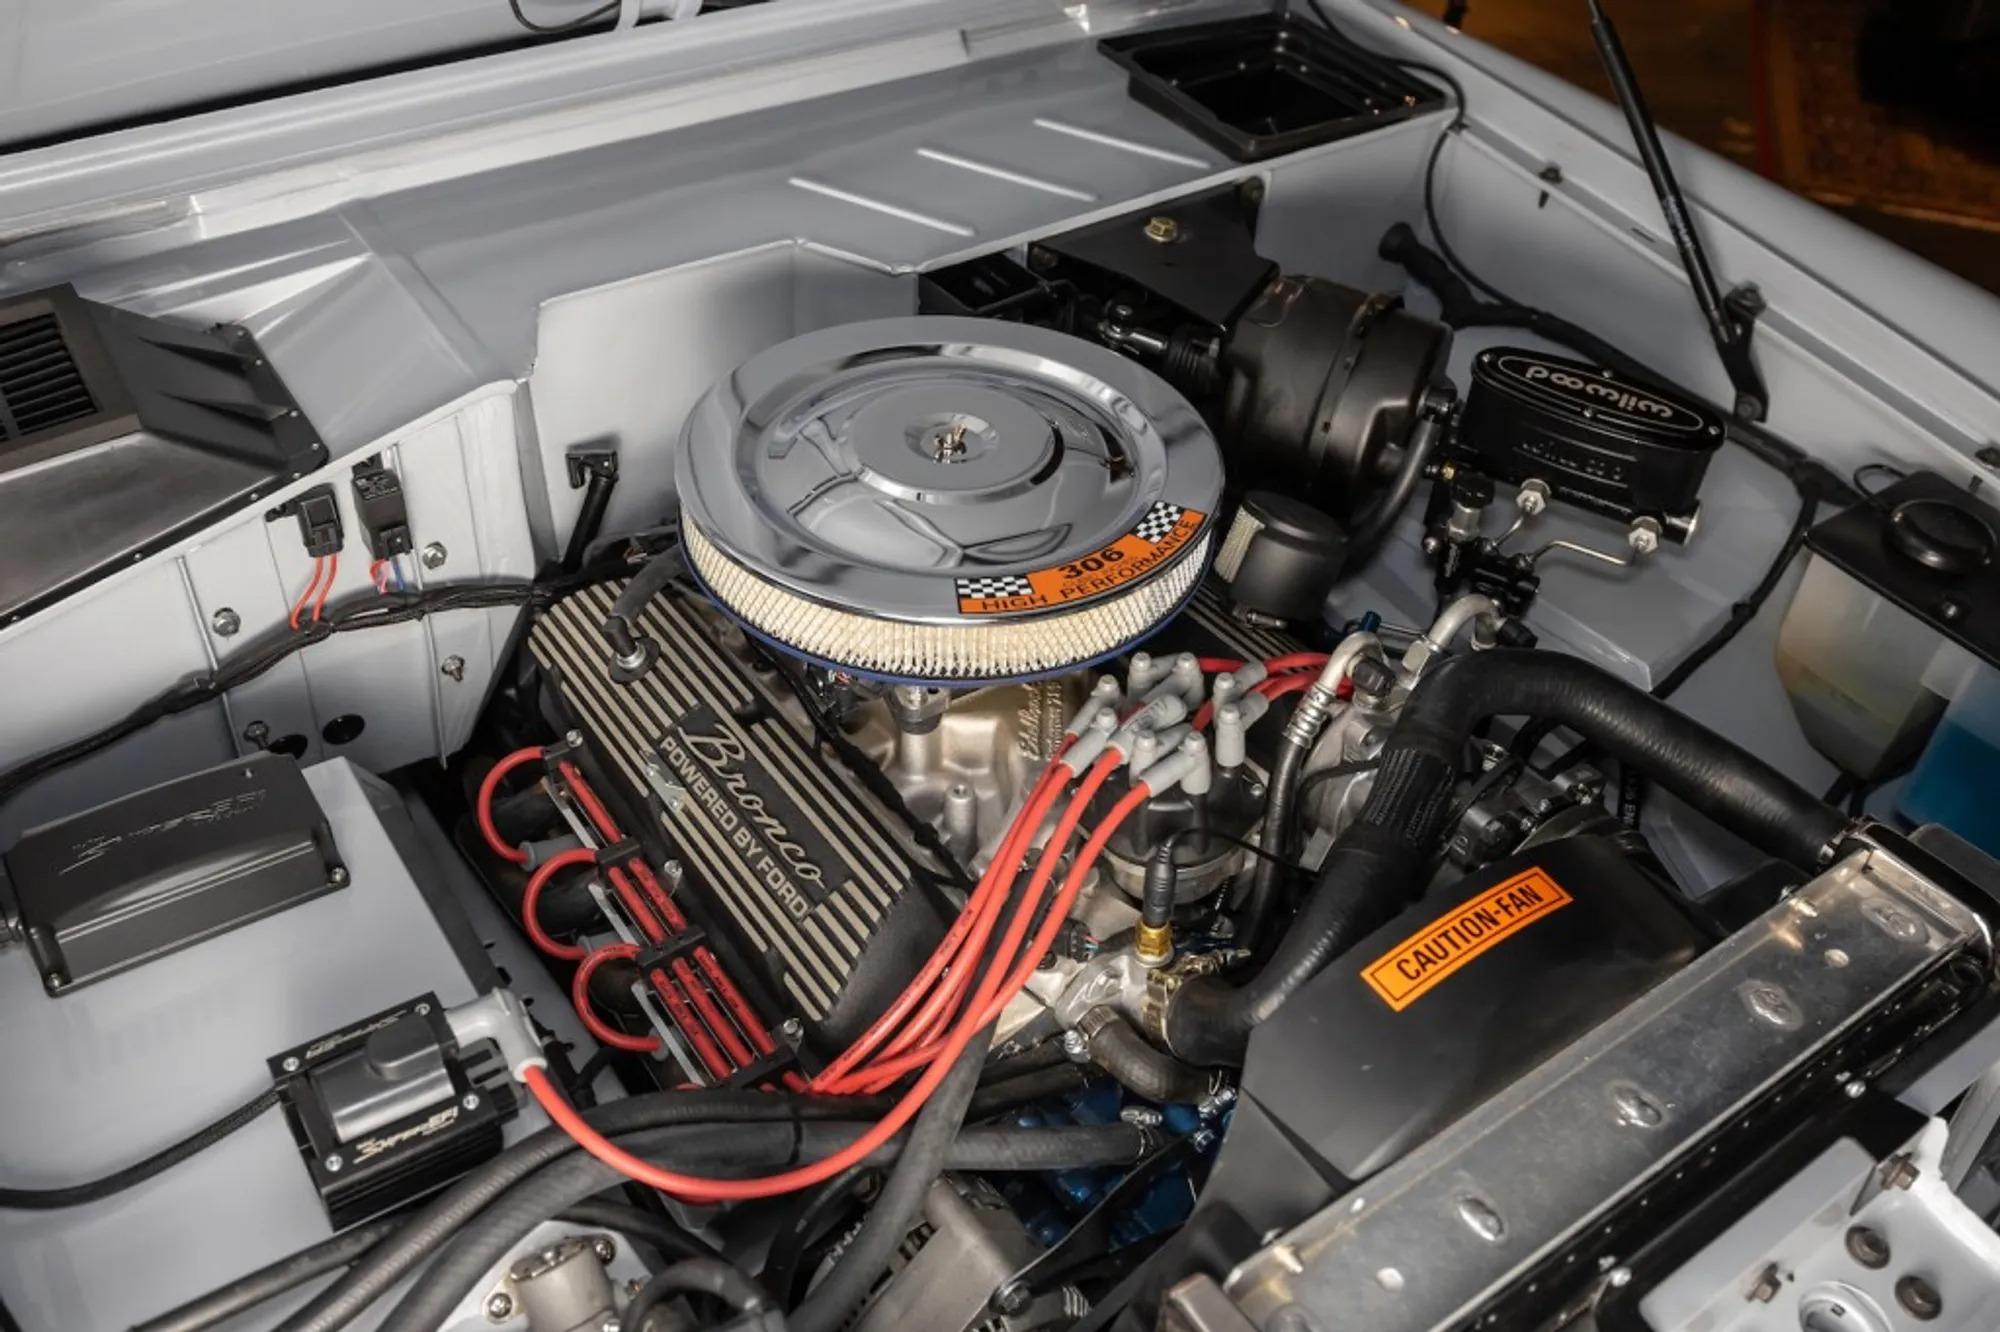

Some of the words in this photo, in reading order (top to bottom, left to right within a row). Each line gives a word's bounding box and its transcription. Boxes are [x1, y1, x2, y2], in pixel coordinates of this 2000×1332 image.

[1525, 366, 1674, 419] wilwood
[981, 594, 1049, 611] HIGH
[1060, 518, 1195, 599] PERFORMANCE
[1057, 548, 1125, 580] 306
[659, 736, 739, 832] POWERED
[733, 831, 763, 857] BY
[756, 856, 808, 918] FORD
[677, 723, 826, 889] Bronco
[1396, 884, 1545, 981] CAUTION-FAN
